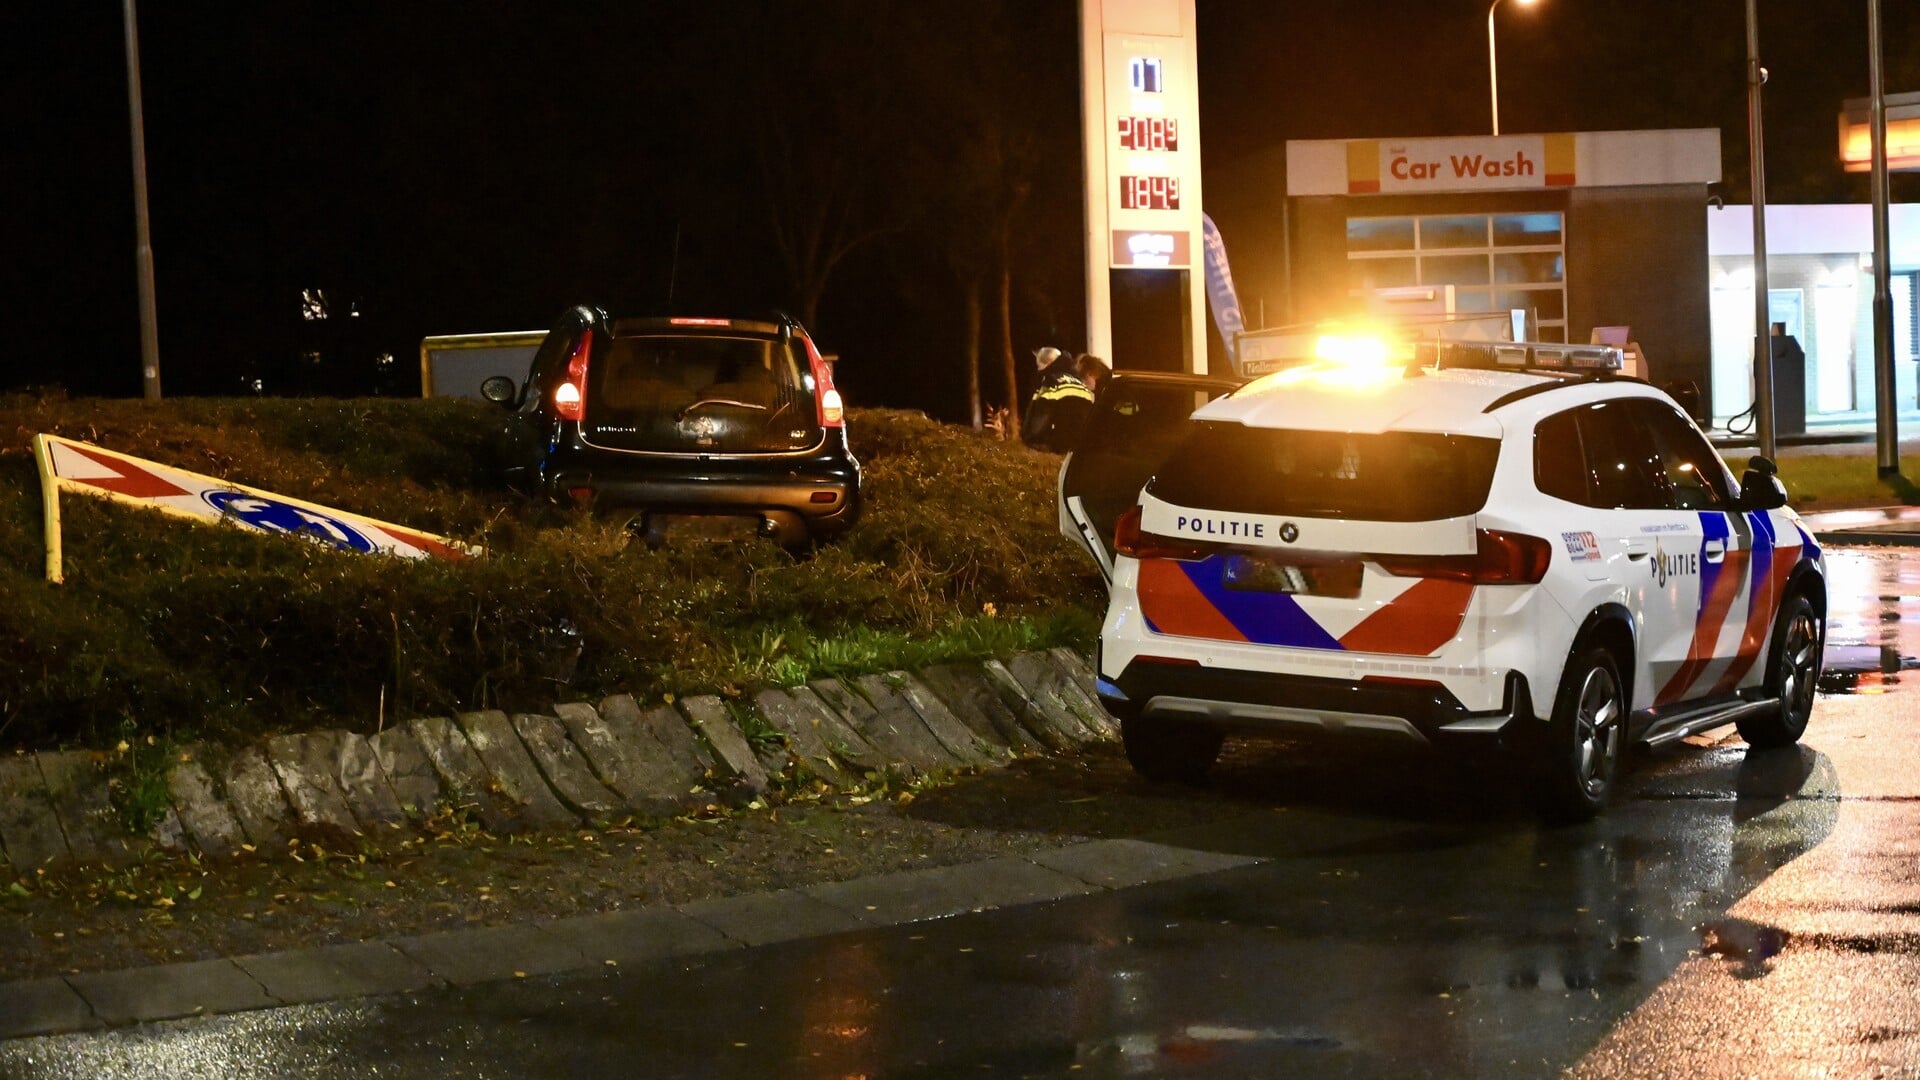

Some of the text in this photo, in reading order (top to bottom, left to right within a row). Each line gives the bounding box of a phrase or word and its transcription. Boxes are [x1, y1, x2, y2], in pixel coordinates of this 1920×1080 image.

[1390, 150, 1534, 180] Car Wash
[1177, 516, 1264, 538] POLITIE
[1578, 531, 1598, 548] 112
[1650, 552, 1697, 588] POLITIE
